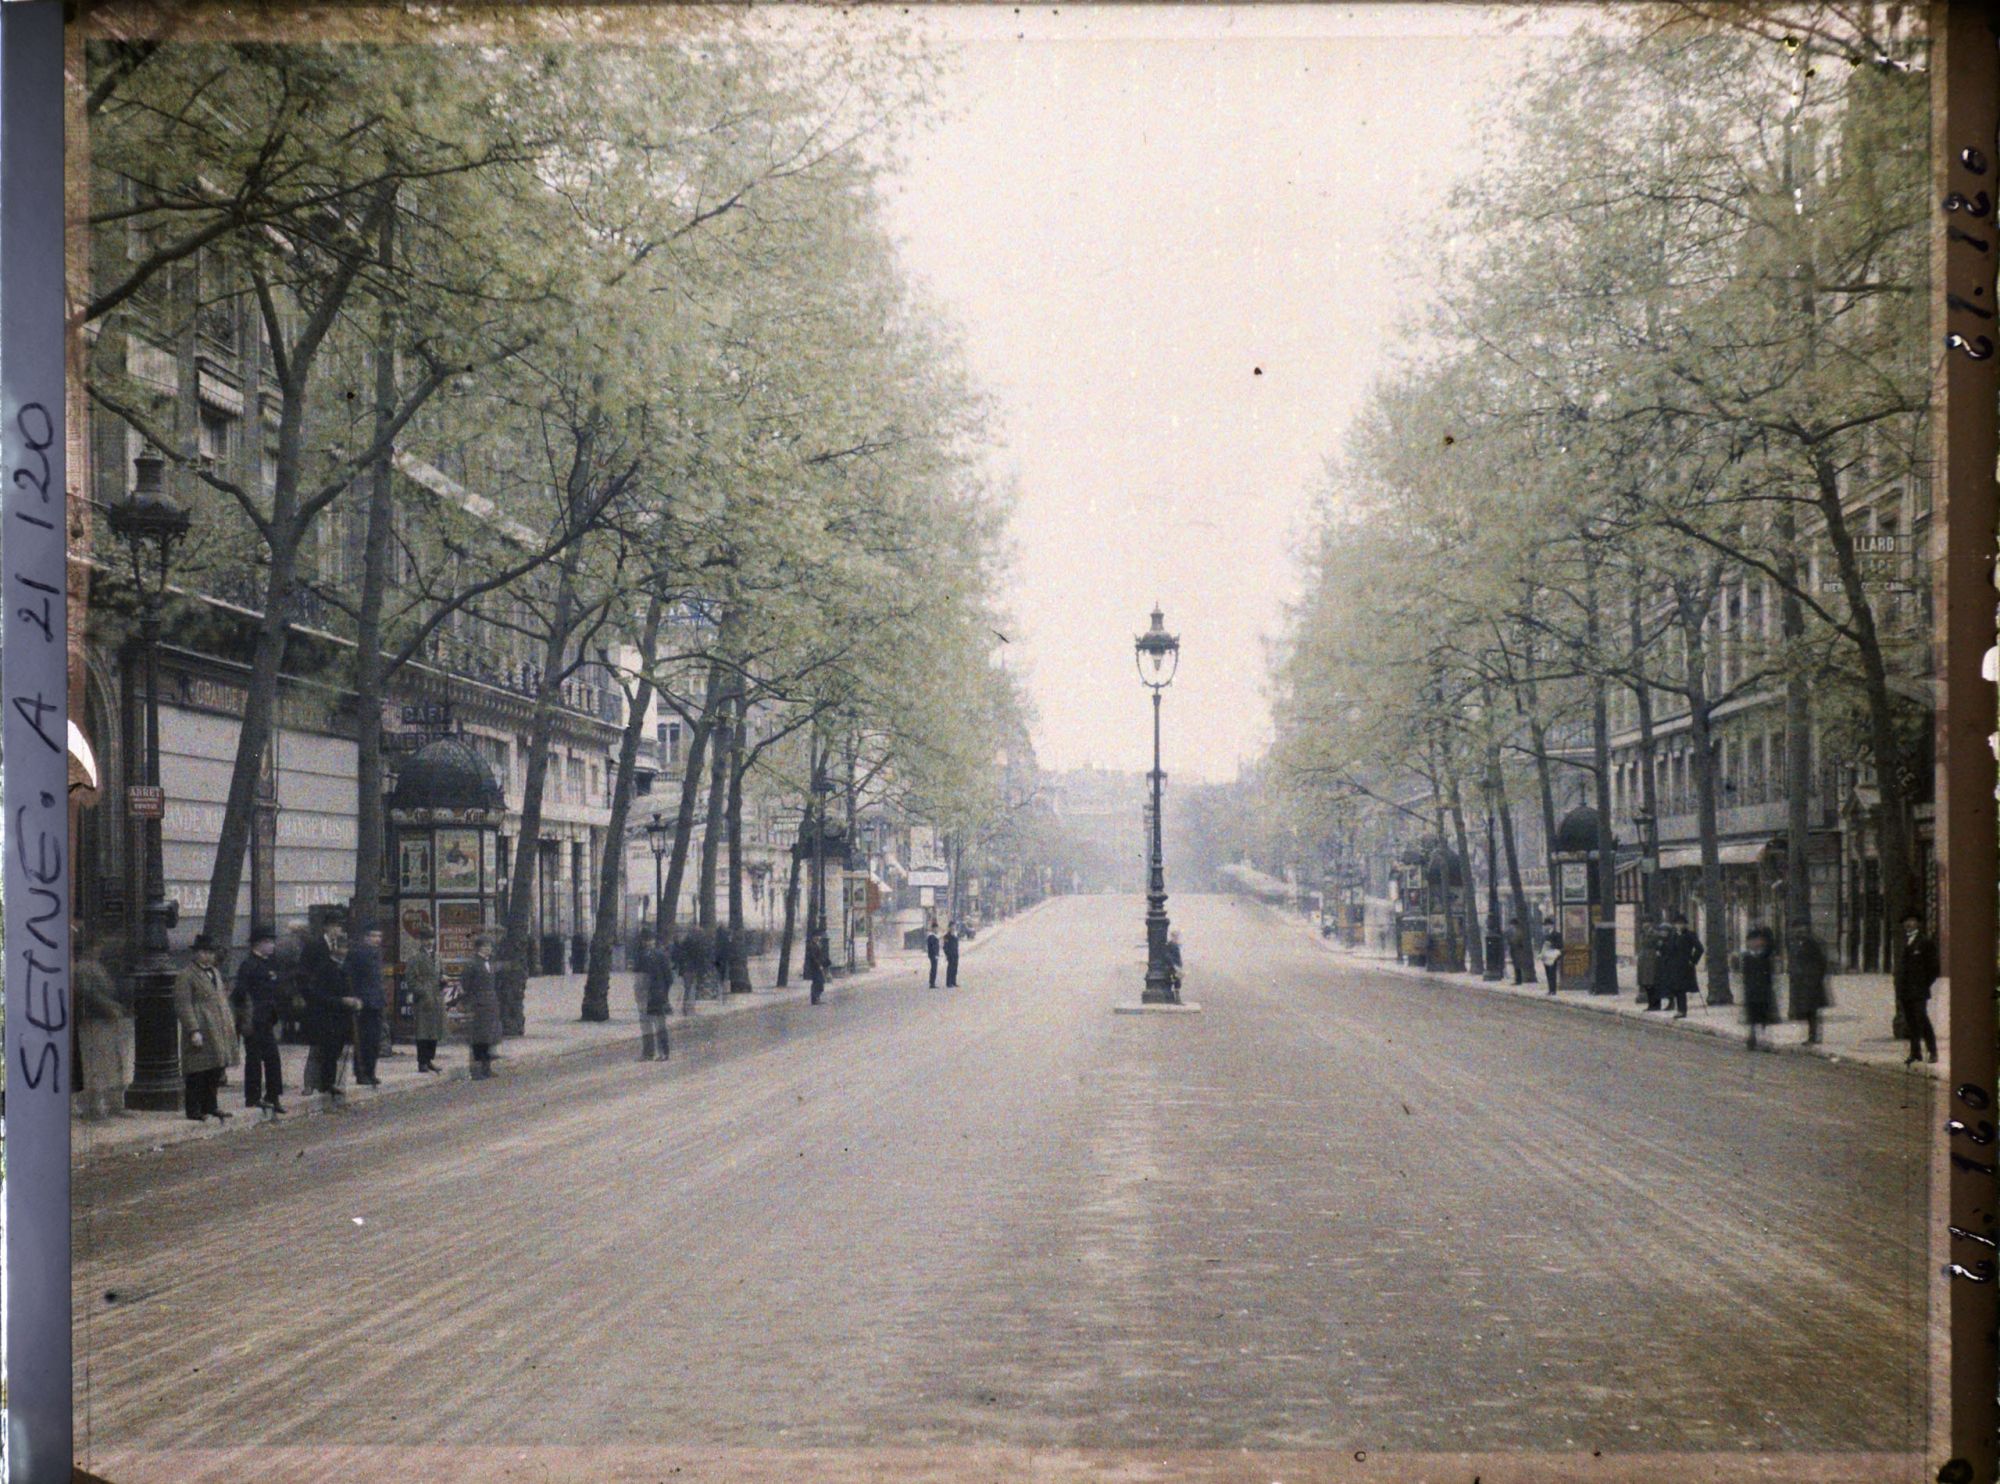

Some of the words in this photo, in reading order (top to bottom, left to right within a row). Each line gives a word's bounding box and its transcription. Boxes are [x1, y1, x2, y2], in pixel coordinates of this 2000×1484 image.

[1941, 147, 1990, 253] 120
[11, 402, 57, 530] 120
[1853, 536, 1895, 553] LLARD
[15, 577, 62, 640] 21
[13, 690, 61, 755] A
